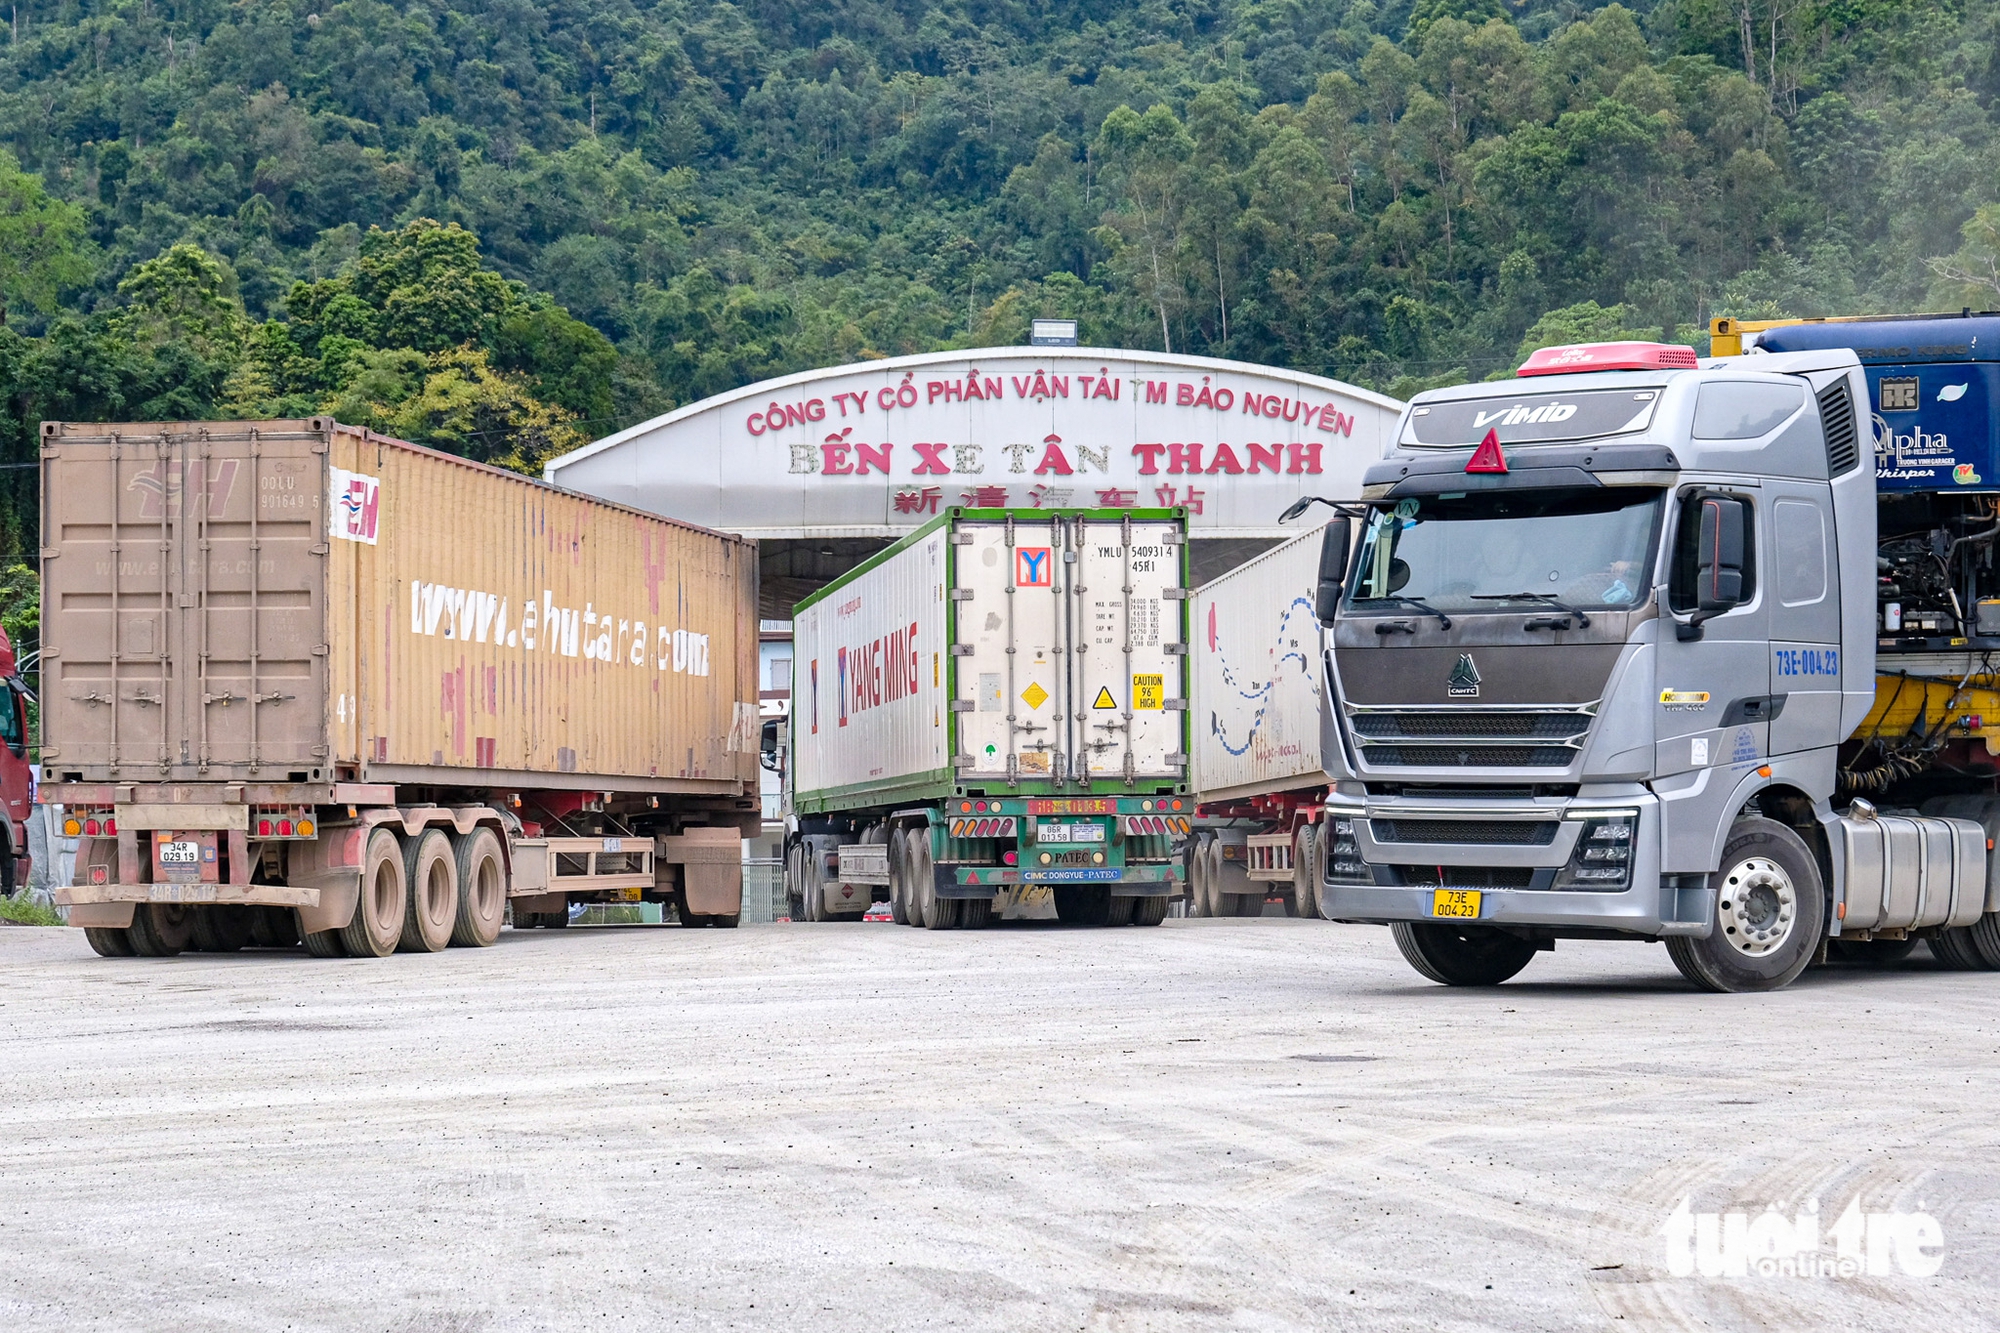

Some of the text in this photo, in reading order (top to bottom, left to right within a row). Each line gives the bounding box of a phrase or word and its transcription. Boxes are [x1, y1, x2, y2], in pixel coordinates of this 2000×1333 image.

[1917, 344, 1969, 356] KING
[747, 398, 826, 436] CÔNG
[832, 390, 870, 416] TY
[877, 371, 918, 410] CỔ
[927, 368, 1003, 404] PHẦN
[1012, 369, 1069, 403] VẬN
[1078, 367, 1121, 401] TẢI
[1177, 376, 1235, 411] BẢO
[1242, 391, 1355, 437] NGUYÊN
[788, 427, 1324, 475] BẾN XE TÂN THANH
[261, 495, 304, 508] 901649
[1098, 547, 1122, 558] YMLU
[1132, 560, 1155, 572] 45R1
[849, 639, 880, 714] YANG
[884, 621, 918, 704] MING
[1776, 650, 1838, 676] 73E-004.23
[1133, 676, 1162, 686] CAUTION
[1140, 698, 1156, 708] HIGH
[171, 843, 187, 851] 34R
[164, 852, 194, 861] 029.19
[1055, 852, 1089, 863] PATEC
[1024, 872, 1047, 880] CIMC
[1448, 891, 1467, 903] 73E
[1438, 904, 1474, 917] 004.23
